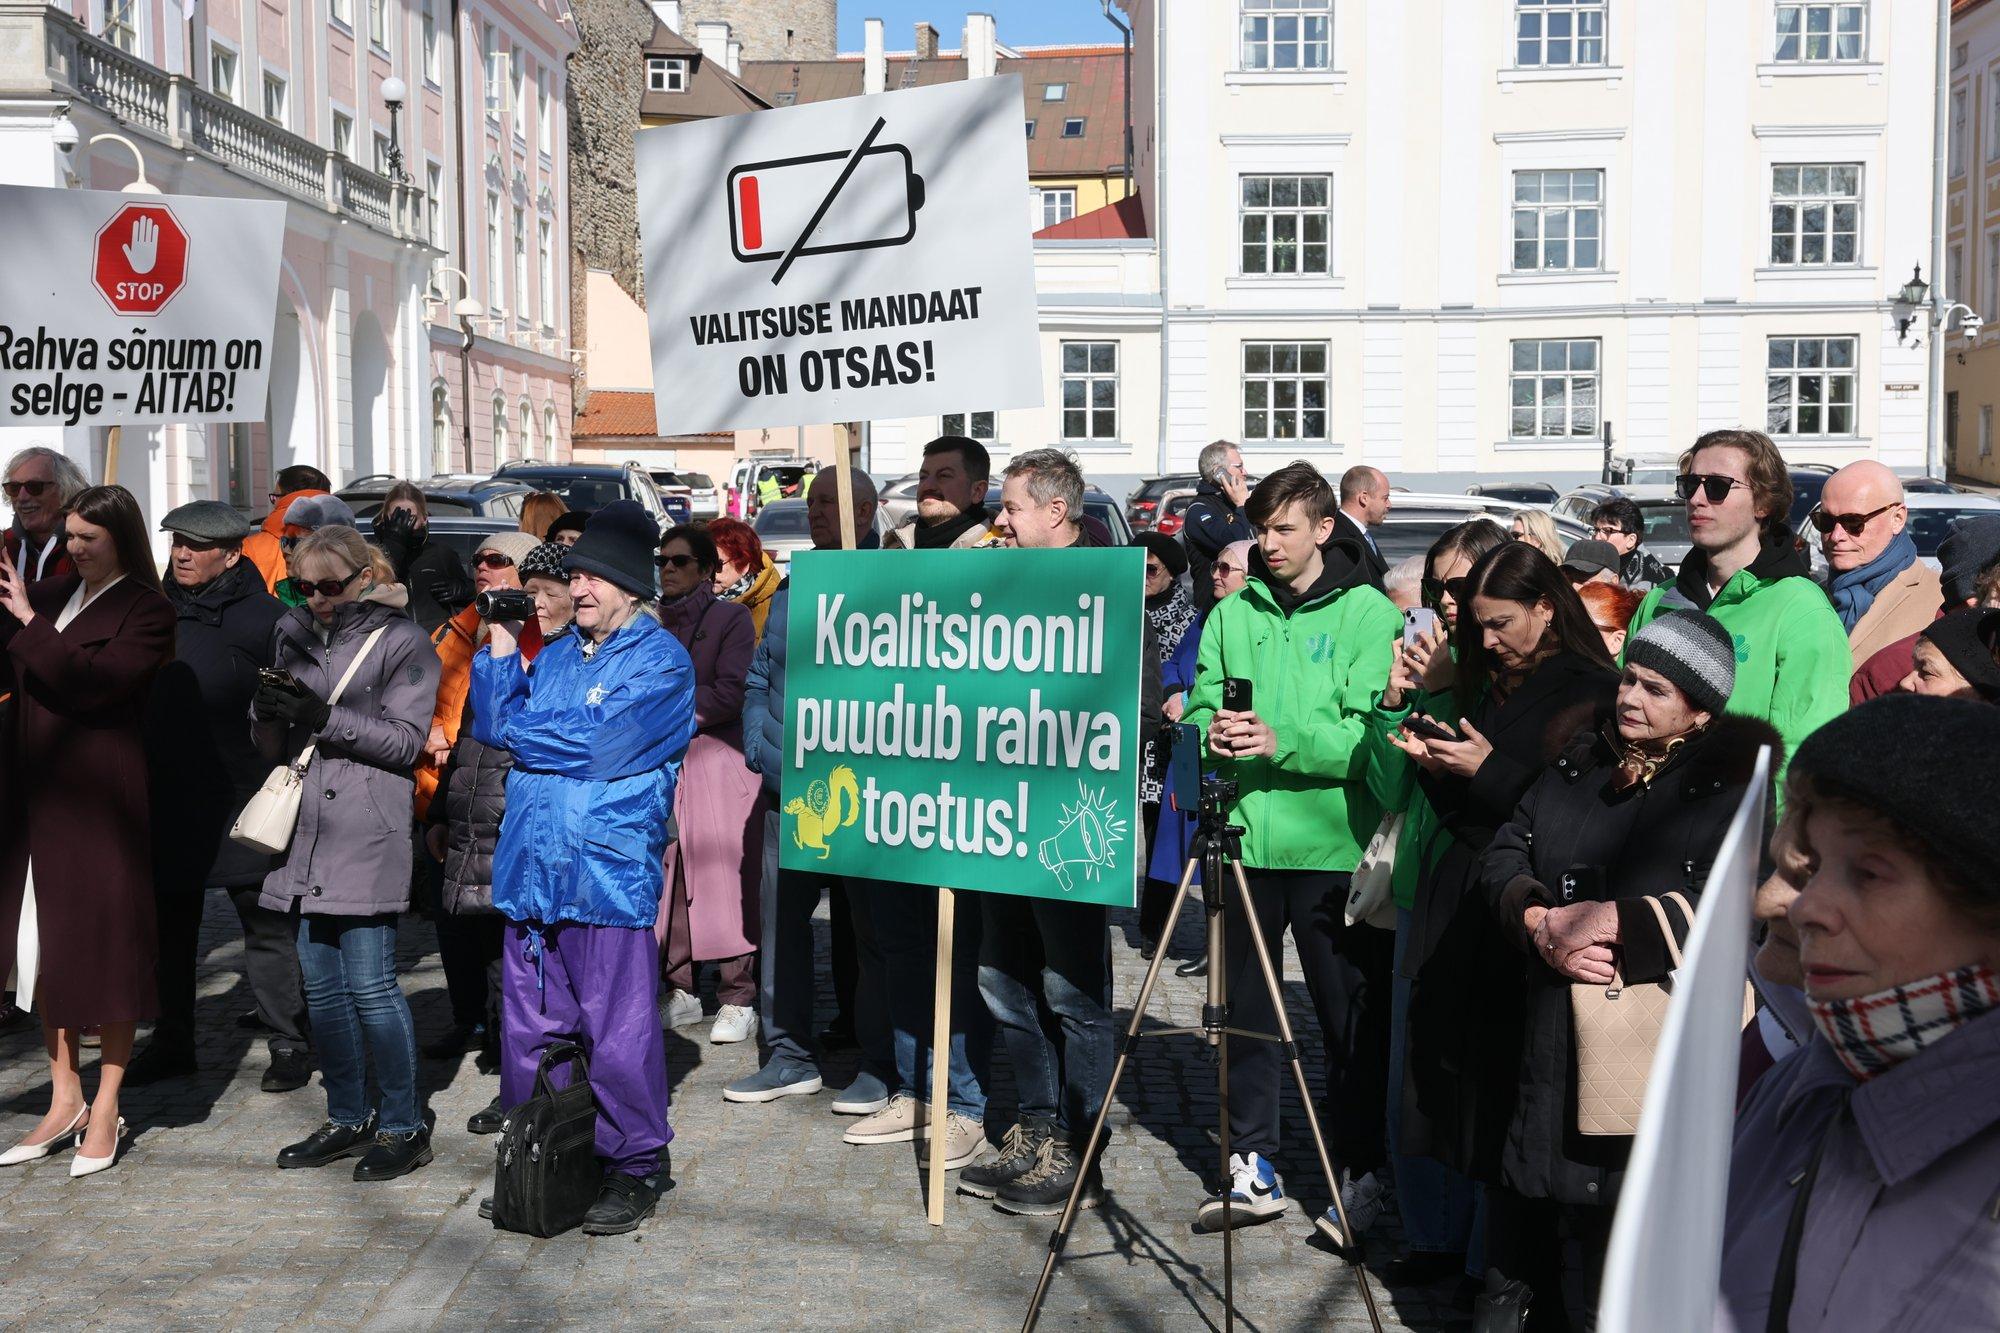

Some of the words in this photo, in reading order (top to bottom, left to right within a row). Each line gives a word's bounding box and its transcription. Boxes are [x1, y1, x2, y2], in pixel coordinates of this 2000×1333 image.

[115, 282, 164, 300] STOP
[691, 302, 832, 346] VALITSUSE
[841, 287, 982, 331] MANDAAT
[107, 327, 216, 370] sõnum
[225, 339, 262, 370] on
[738, 354, 788, 398] ON
[799, 340, 935, 393] OTSAS!
[10, 373, 104, 426] selge
[134, 371, 236, 414] AITAB!
[815, 592, 1105, 674] Koalitsioonil
[795, 683, 962, 768] puudub
[976, 689, 1121, 771] rahva
[862, 777, 1028, 858] toetus!
